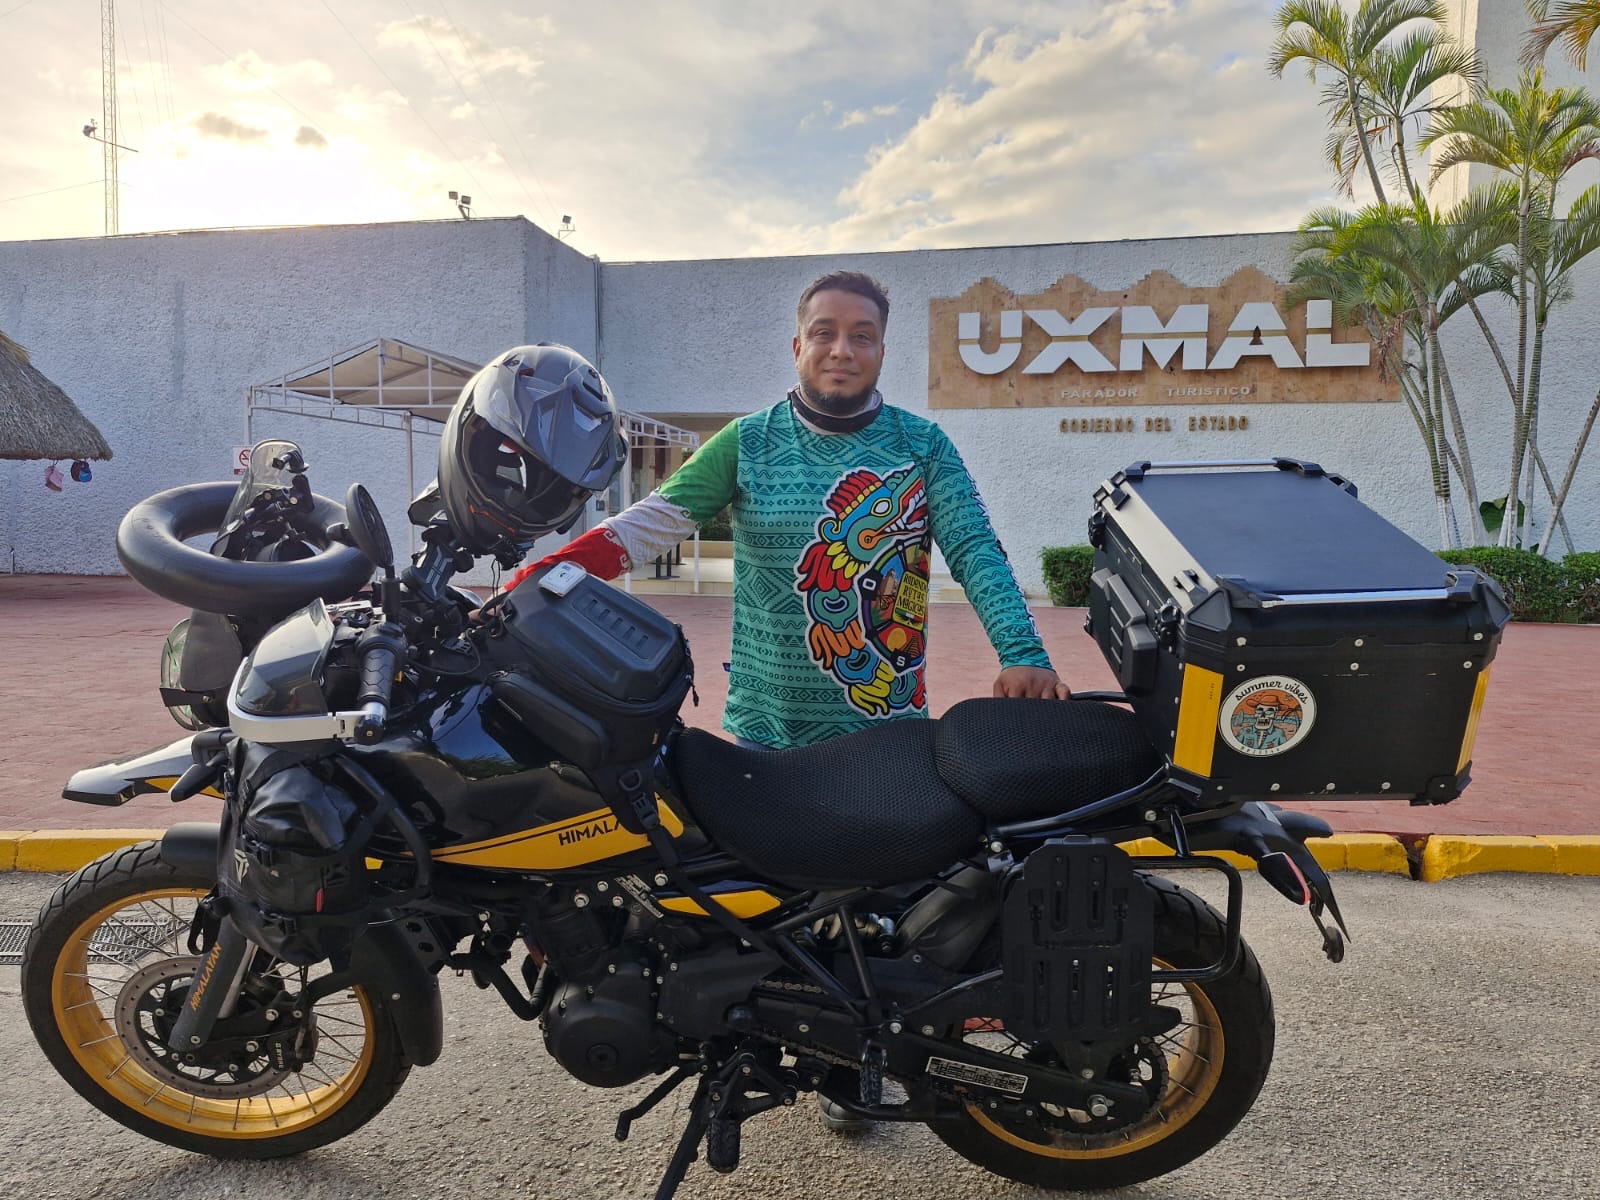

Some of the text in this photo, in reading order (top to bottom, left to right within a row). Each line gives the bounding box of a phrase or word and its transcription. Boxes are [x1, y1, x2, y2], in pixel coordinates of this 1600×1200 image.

[958, 300, 1370, 375] UXMAL
[1061, 386, 1250, 398] PARADOR TURISTICO
[1060, 415, 1249, 433] GOBIERNO DEL ESTADO
[896, 655, 905, 667] S
[1235, 680, 1282, 701] summer
[1284, 683, 1309, 704] vibes
[191, 941, 222, 1012] HIMALAYAN
